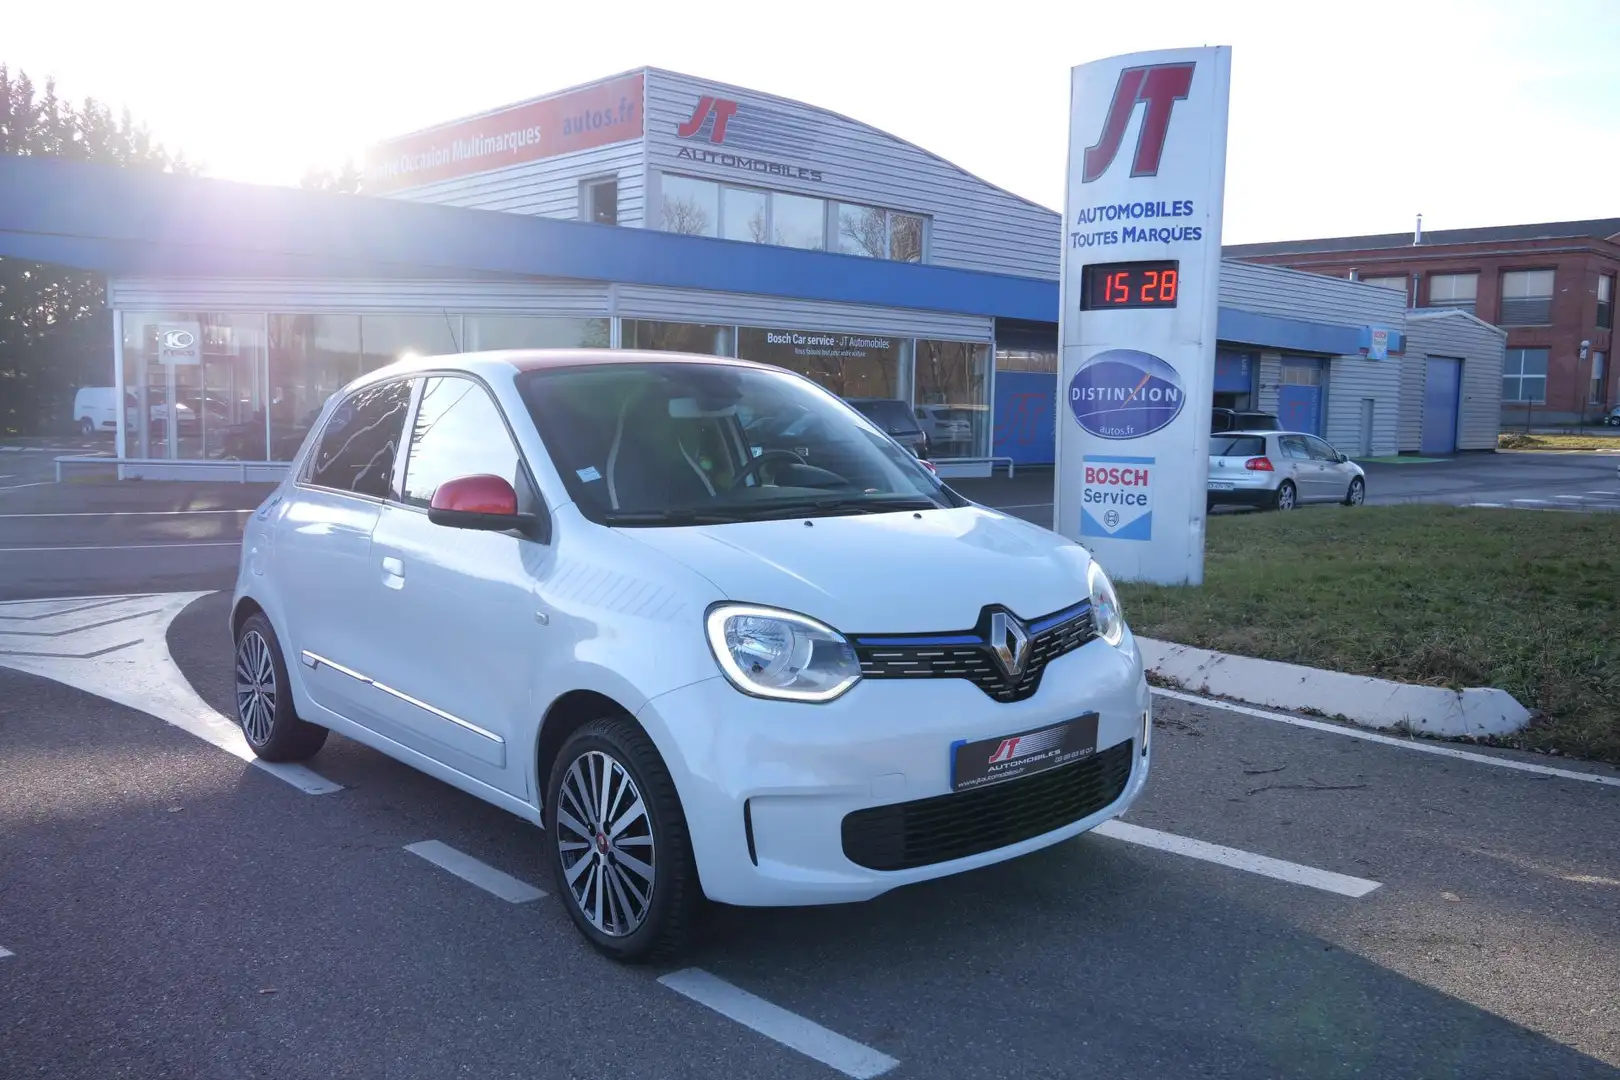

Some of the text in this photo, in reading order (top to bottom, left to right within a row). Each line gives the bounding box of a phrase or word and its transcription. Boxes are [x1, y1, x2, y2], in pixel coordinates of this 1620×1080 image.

[677, 96, 738, 144] JT
[1082, 61, 1197, 184] JT
[401, 145, 450, 172] Occasion
[452, 125, 542, 161] Multimarques
[563, 96, 634, 136] autos.fr
[676, 147, 823, 182] AUTOMOBILES
[1077, 200, 1193, 225] AUTOMOBILES
[1071, 226, 1202, 248] TOUTES MARQUES
[1105, 270, 1177, 303] 15 28
[767, 332, 791, 344] Bosch
[792, 334, 806, 345] Car
[807, 335, 835, 346] service
[839, 336, 848, 346] JT
[849, 337, 890, 349] Automobiles
[1072, 387, 1178, 403] DISTINXION
[1100, 425, 1134, 436] autos.fr
[1085, 467, 1149, 487] BOSCH
[1083, 488, 1148, 506] Service
[988, 737, 1021, 764] JT
[988, 748, 1061, 773] AUTOMOBILES
